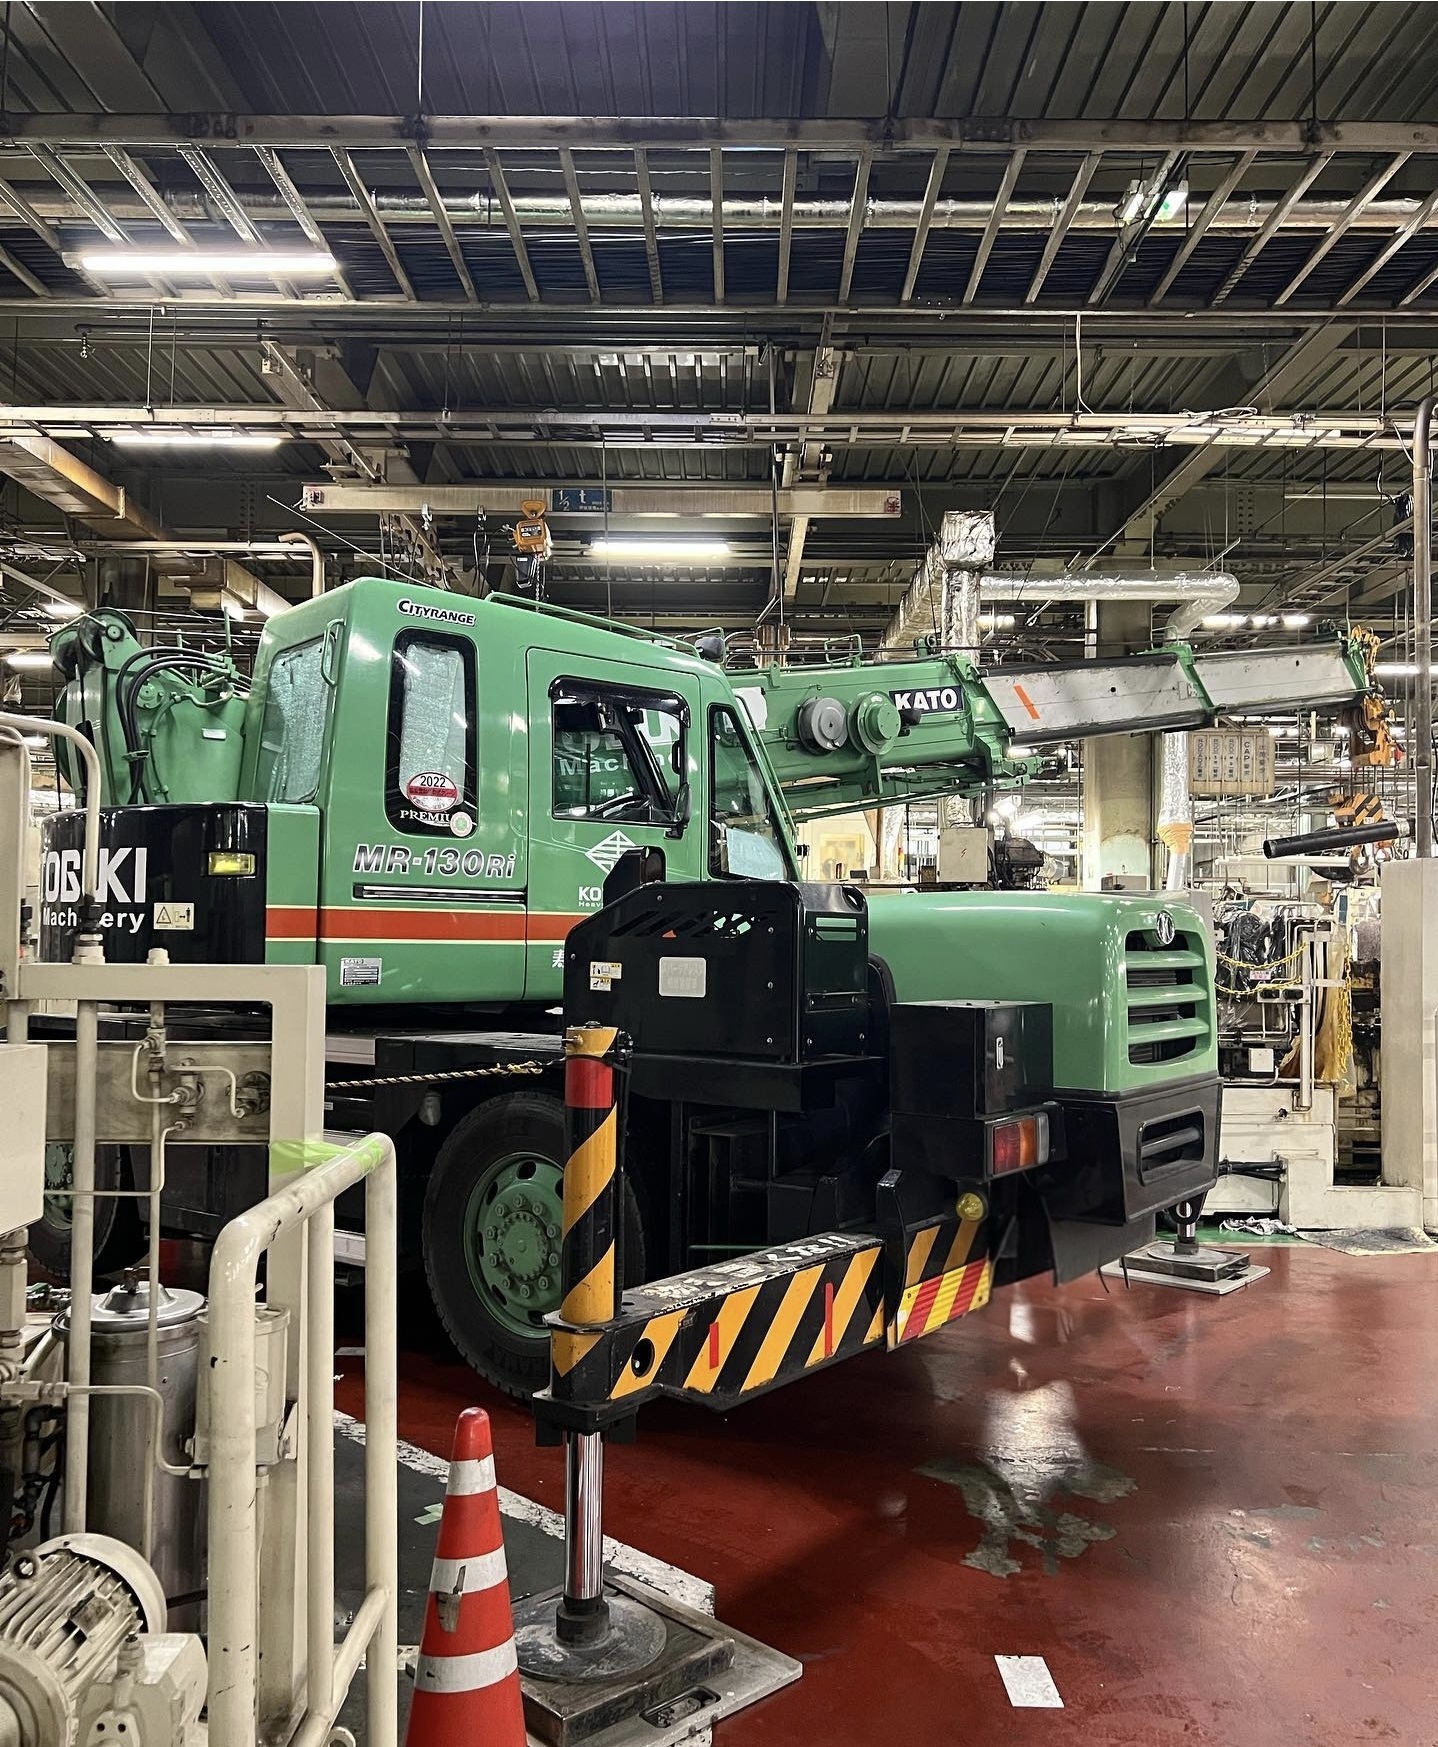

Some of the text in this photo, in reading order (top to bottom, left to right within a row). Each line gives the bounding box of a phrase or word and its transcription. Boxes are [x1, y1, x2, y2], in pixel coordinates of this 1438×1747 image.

[894, 688, 957, 710] KATO
[420, 775, 446, 788] 2022
[43, 907, 145, 933] Machery
